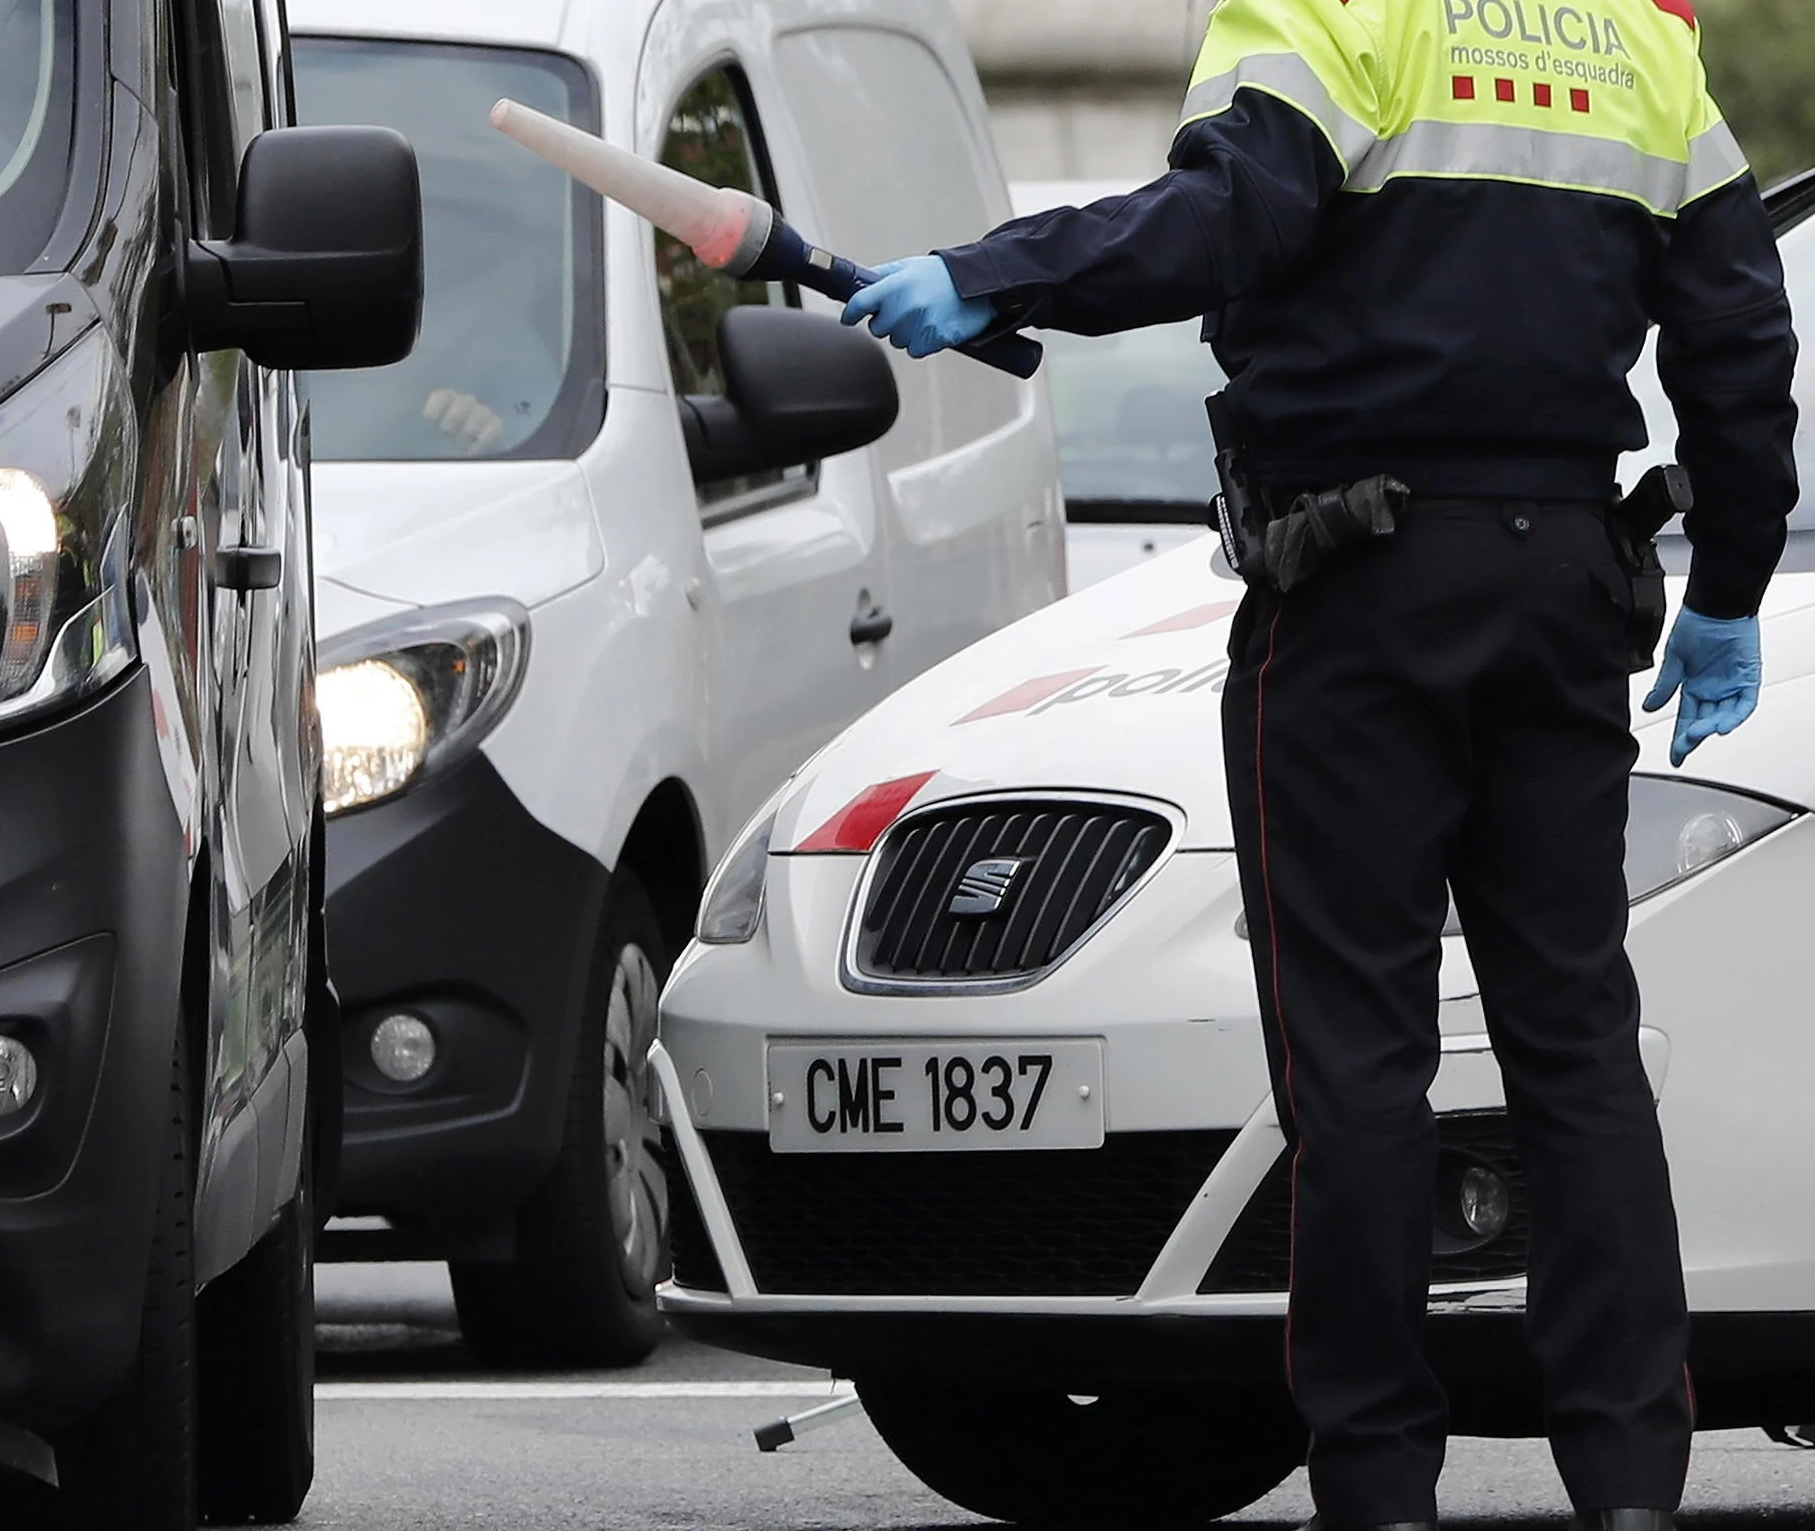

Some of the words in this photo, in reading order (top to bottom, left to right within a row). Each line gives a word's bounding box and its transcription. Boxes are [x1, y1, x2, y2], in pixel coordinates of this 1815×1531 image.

[1450, 45, 1530, 72] mossos
[1535, 50, 1635, 90] d'esquadra
[1024, 657, 1230, 718] poli
[806, 1057, 905, 1134] CME
[924, 1054, 1053, 1132] 1837
